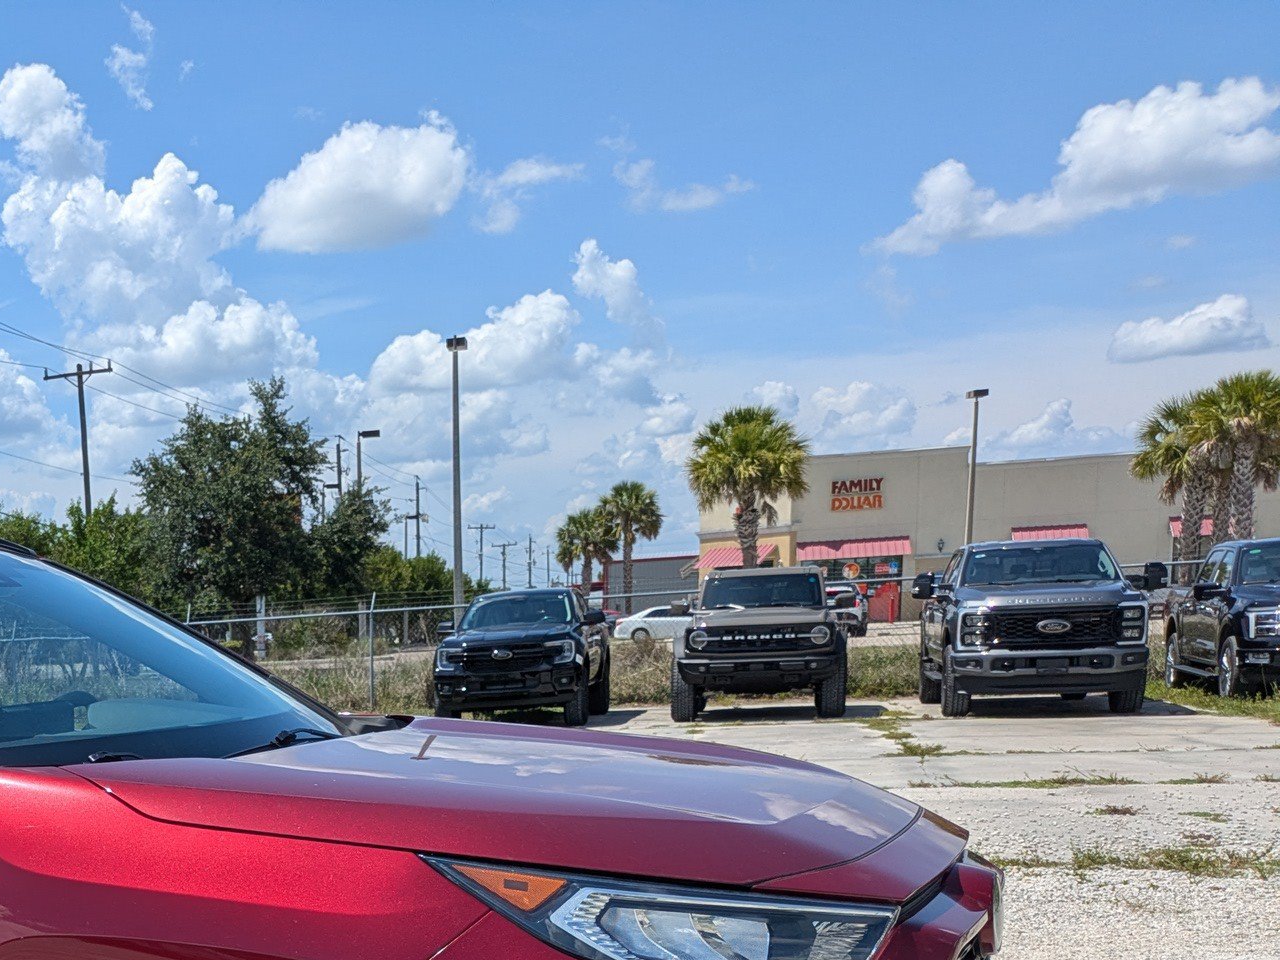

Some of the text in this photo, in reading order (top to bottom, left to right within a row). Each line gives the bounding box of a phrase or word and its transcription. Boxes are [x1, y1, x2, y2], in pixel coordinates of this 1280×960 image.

[831, 477, 884, 495] FAMILY
[831, 494, 883, 512] DOLLAR
[722, 633, 796, 641] BRONCO
